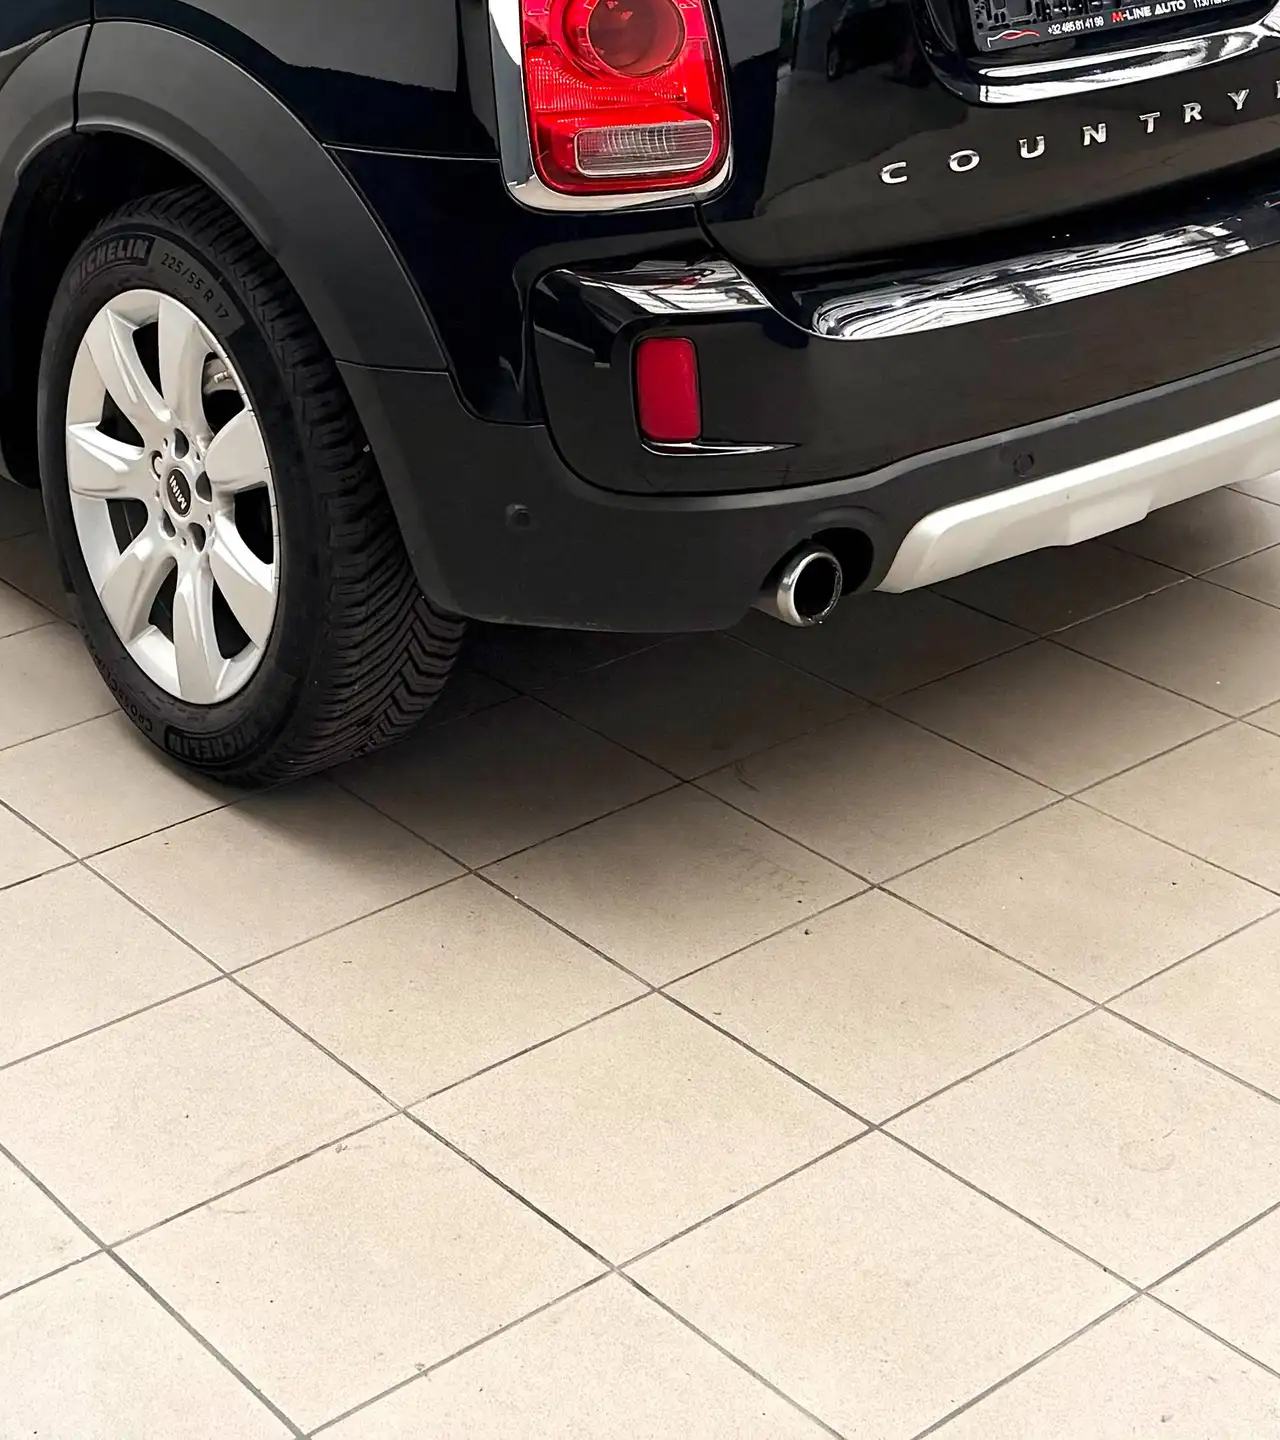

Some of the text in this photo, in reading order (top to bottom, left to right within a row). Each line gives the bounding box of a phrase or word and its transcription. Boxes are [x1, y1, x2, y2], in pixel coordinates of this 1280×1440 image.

[1111, 6, 1152, 23] M-LINE
[1155, 0, 1186, 15] AUTO
[160, 252, 207, 291] 225/55
[203, 288, 215, 303] R
[215, 304, 230, 320] 17
[169, 475, 187, 510] MINI
